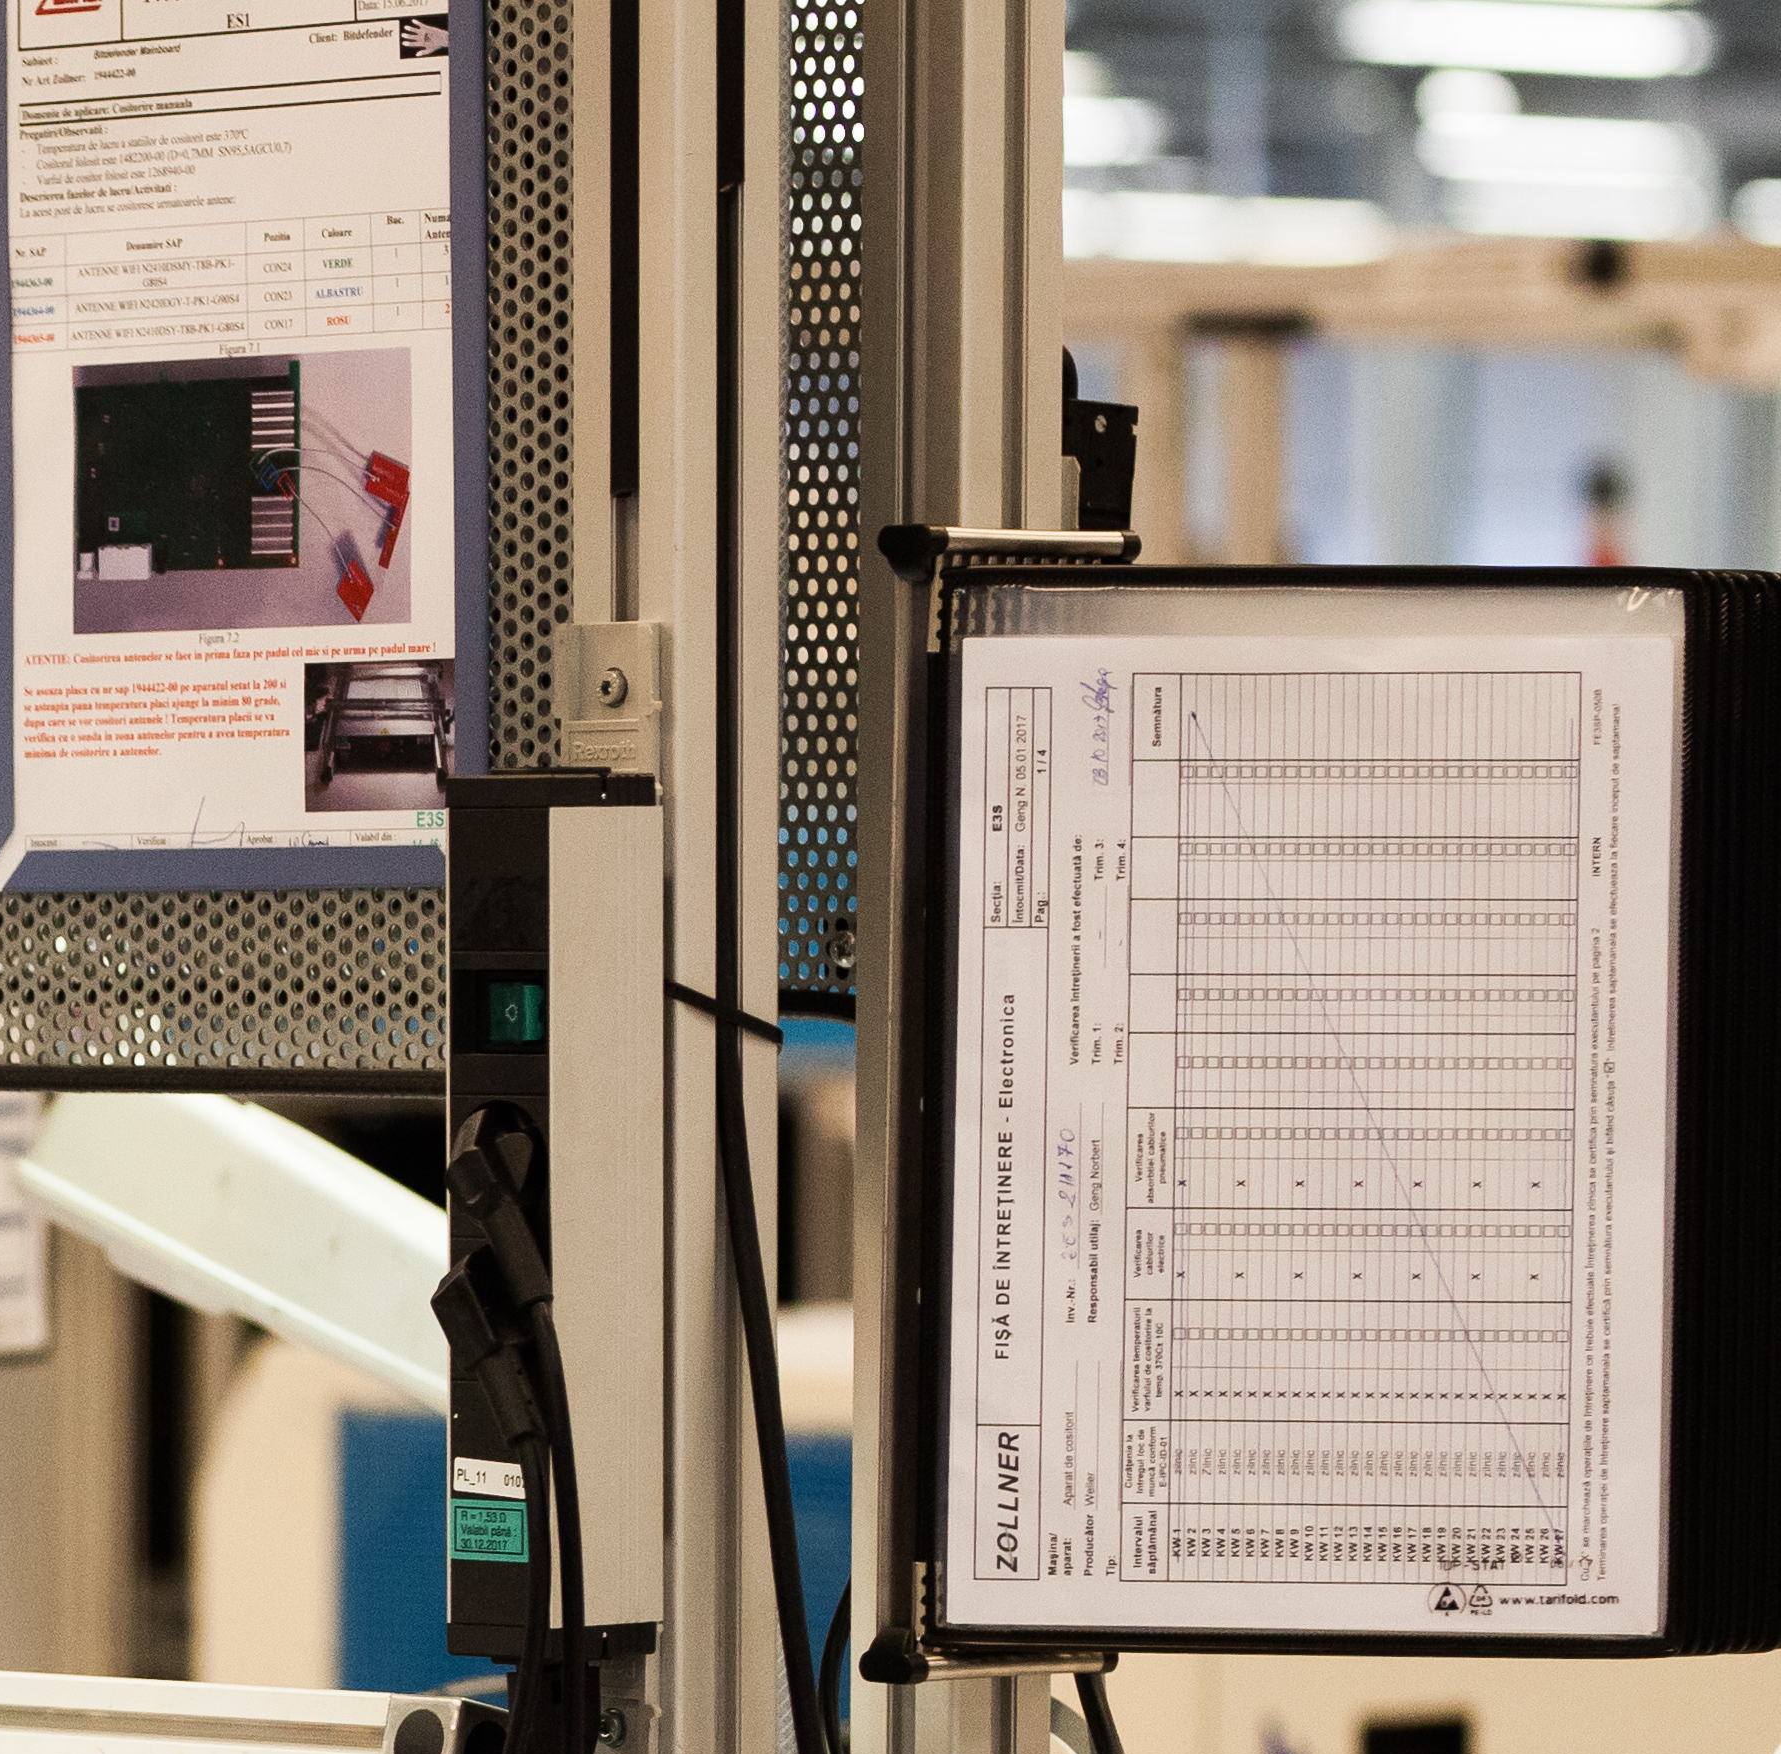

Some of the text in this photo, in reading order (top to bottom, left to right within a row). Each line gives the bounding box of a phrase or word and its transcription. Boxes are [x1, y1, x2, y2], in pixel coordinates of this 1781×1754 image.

[226, 13, 250, 28] ES1
[309, 28, 393, 44] Client: Bitdefender
[322, 258, 353, 269] VERDE
[315, 287, 362, 299] ALBASTRU
[1037, 749, 1047, 757] 4
[416, 811, 445, 828] E3S
[992, 805, 1003, 832] E3S
[1014, 800, 1029, 832] Geng
[1072, 834, 1082, 852] de:
[1093, 839, 1104, 881] Trim. 3:
[1115, 839, 1126, 881] Trim. 4:
[1592, 837, 1601, 877] INTERN
[1034, 892, 1049, 923] Pag.:
[1071, 910, 1081, 932] fost
[1069, 1005, 1080, 1065] Verificarea
[1091, 1023, 1102, 1065] Trim. 1:
[1113, 1023, 1124, 1065] Trim. 2:
[998, 994, 1016, 1108] Electronica
[1159, 1131, 1169, 1185] pneumatice
[1086, 1138, 1103, 1323] Responsabil utilaj: Geng Norbert
[1133, 1229, 1143, 1278] Verificarea
[1157, 1235, 1166, 1273] electrice
[995, 1278, 1011, 1305] DE
[457, 1468, 524, 1488] PL_11 010
[1084, 1472, 1096, 1506] Weller
[996, 1431, 1020, 1572] ZOLLNER
[1062, 1411, 1075, 1576] aparat: Aparat de cositorit
[461, 1525, 488, 1535] Valabil
[1132, 1515, 1145, 1569] Intervalul
[461, 1539, 507, 1550] 30.12.2017
[1187, 1536, 1197, 1557] KW
[1202, 1536, 1211, 1557] KW
[1217, 1537, 1226, 1557] KW
[1105, 1555, 1119, 1576] Tip:
[1499, 1593, 1619, 1605] www.tarifold.com
